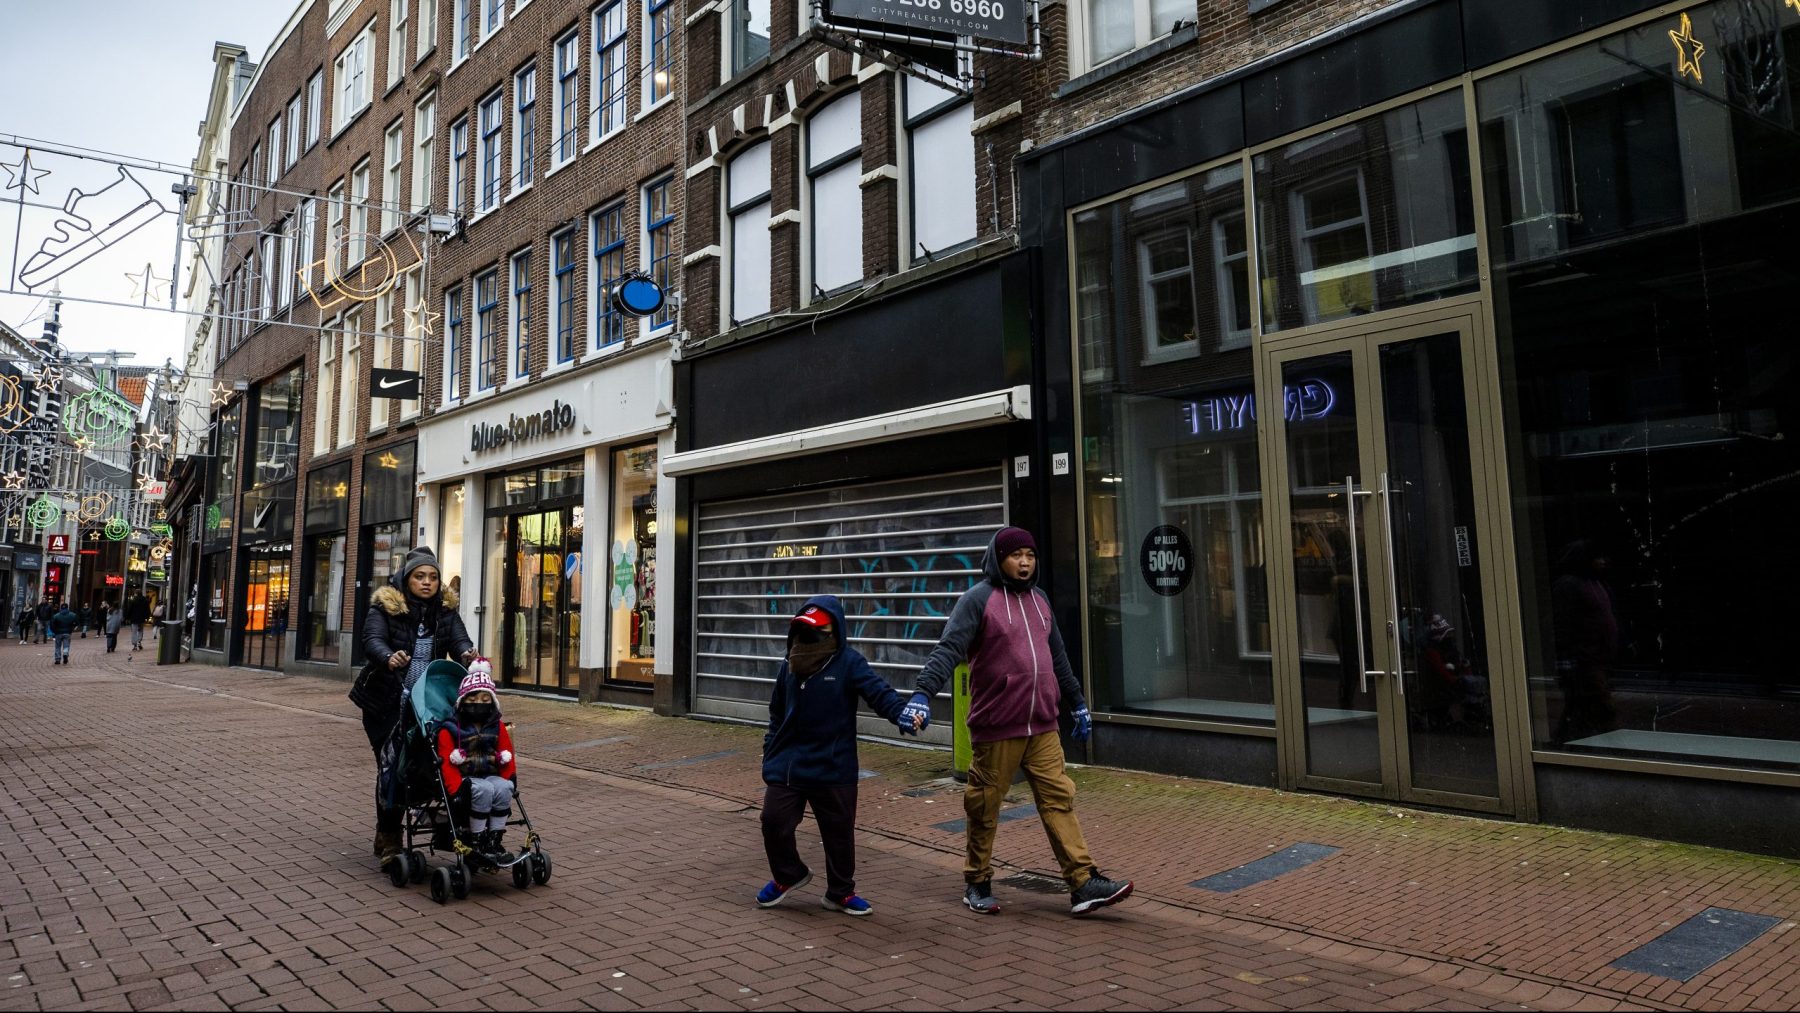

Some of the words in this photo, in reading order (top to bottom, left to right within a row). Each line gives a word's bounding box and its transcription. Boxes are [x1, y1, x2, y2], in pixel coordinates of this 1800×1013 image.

[950, 0, 1005, 20] 6960
[871, 6, 990, 31] CITYREALESTATE.COM
[1016, 461, 1027, 472] 197
[1055, 458, 1067, 470] 199
[1154, 536, 1162, 545] OP
[1162, 535, 1178, 545] ALLES
[1148, 550, 1186, 572] 50%
